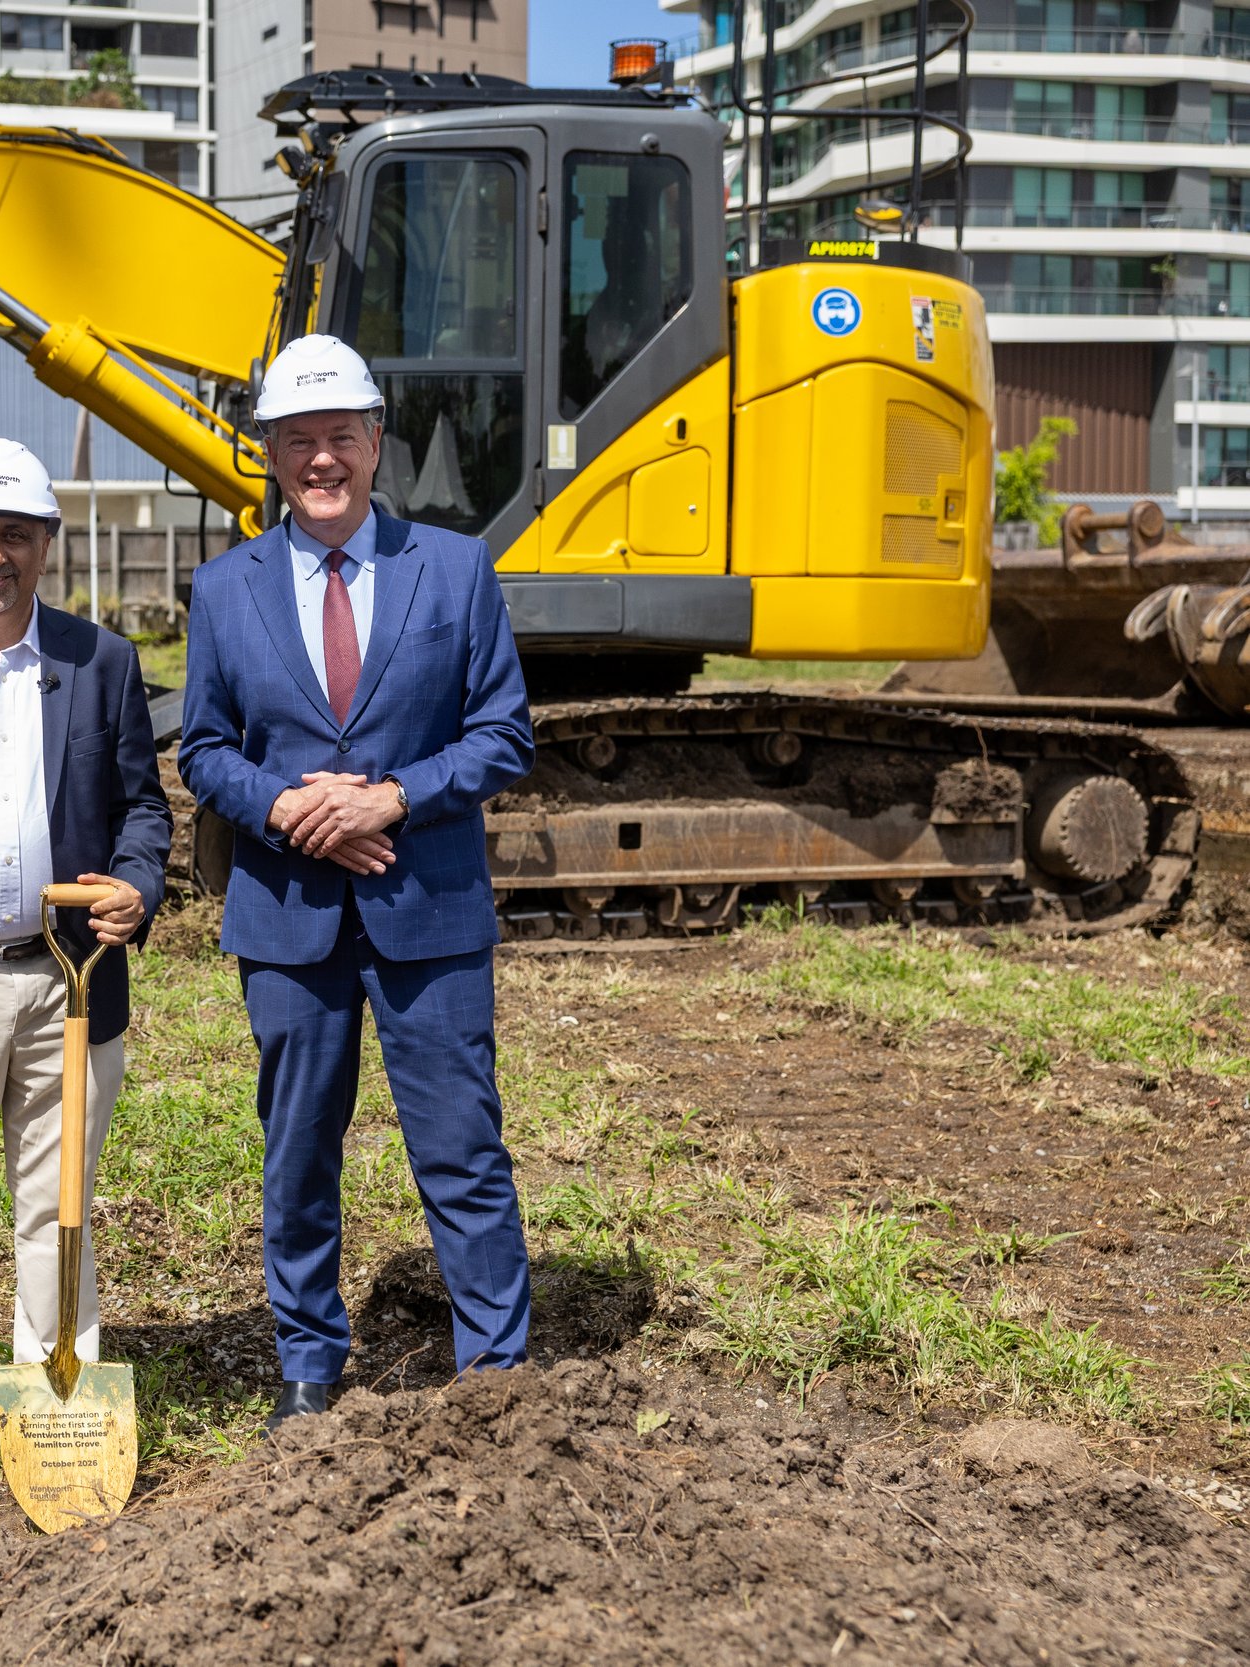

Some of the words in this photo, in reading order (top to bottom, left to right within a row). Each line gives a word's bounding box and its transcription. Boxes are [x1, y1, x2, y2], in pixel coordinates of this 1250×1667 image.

[31, 1412, 100, 1420] commemoration
[104, 1410, 112, 1418] of
[52, 1421, 67, 1429] the
[68, 1421, 85, 1429] first
[106, 1419, 115, 1427] of
[23, 1431, 71, 1439] Wentworth
[34, 1441, 73, 1449] Hamilton
[75, 1440, 102, 1448] Grove.
[41, 1460, 75, 1468] October
[29, 1485, 73, 1493] Wentworth
